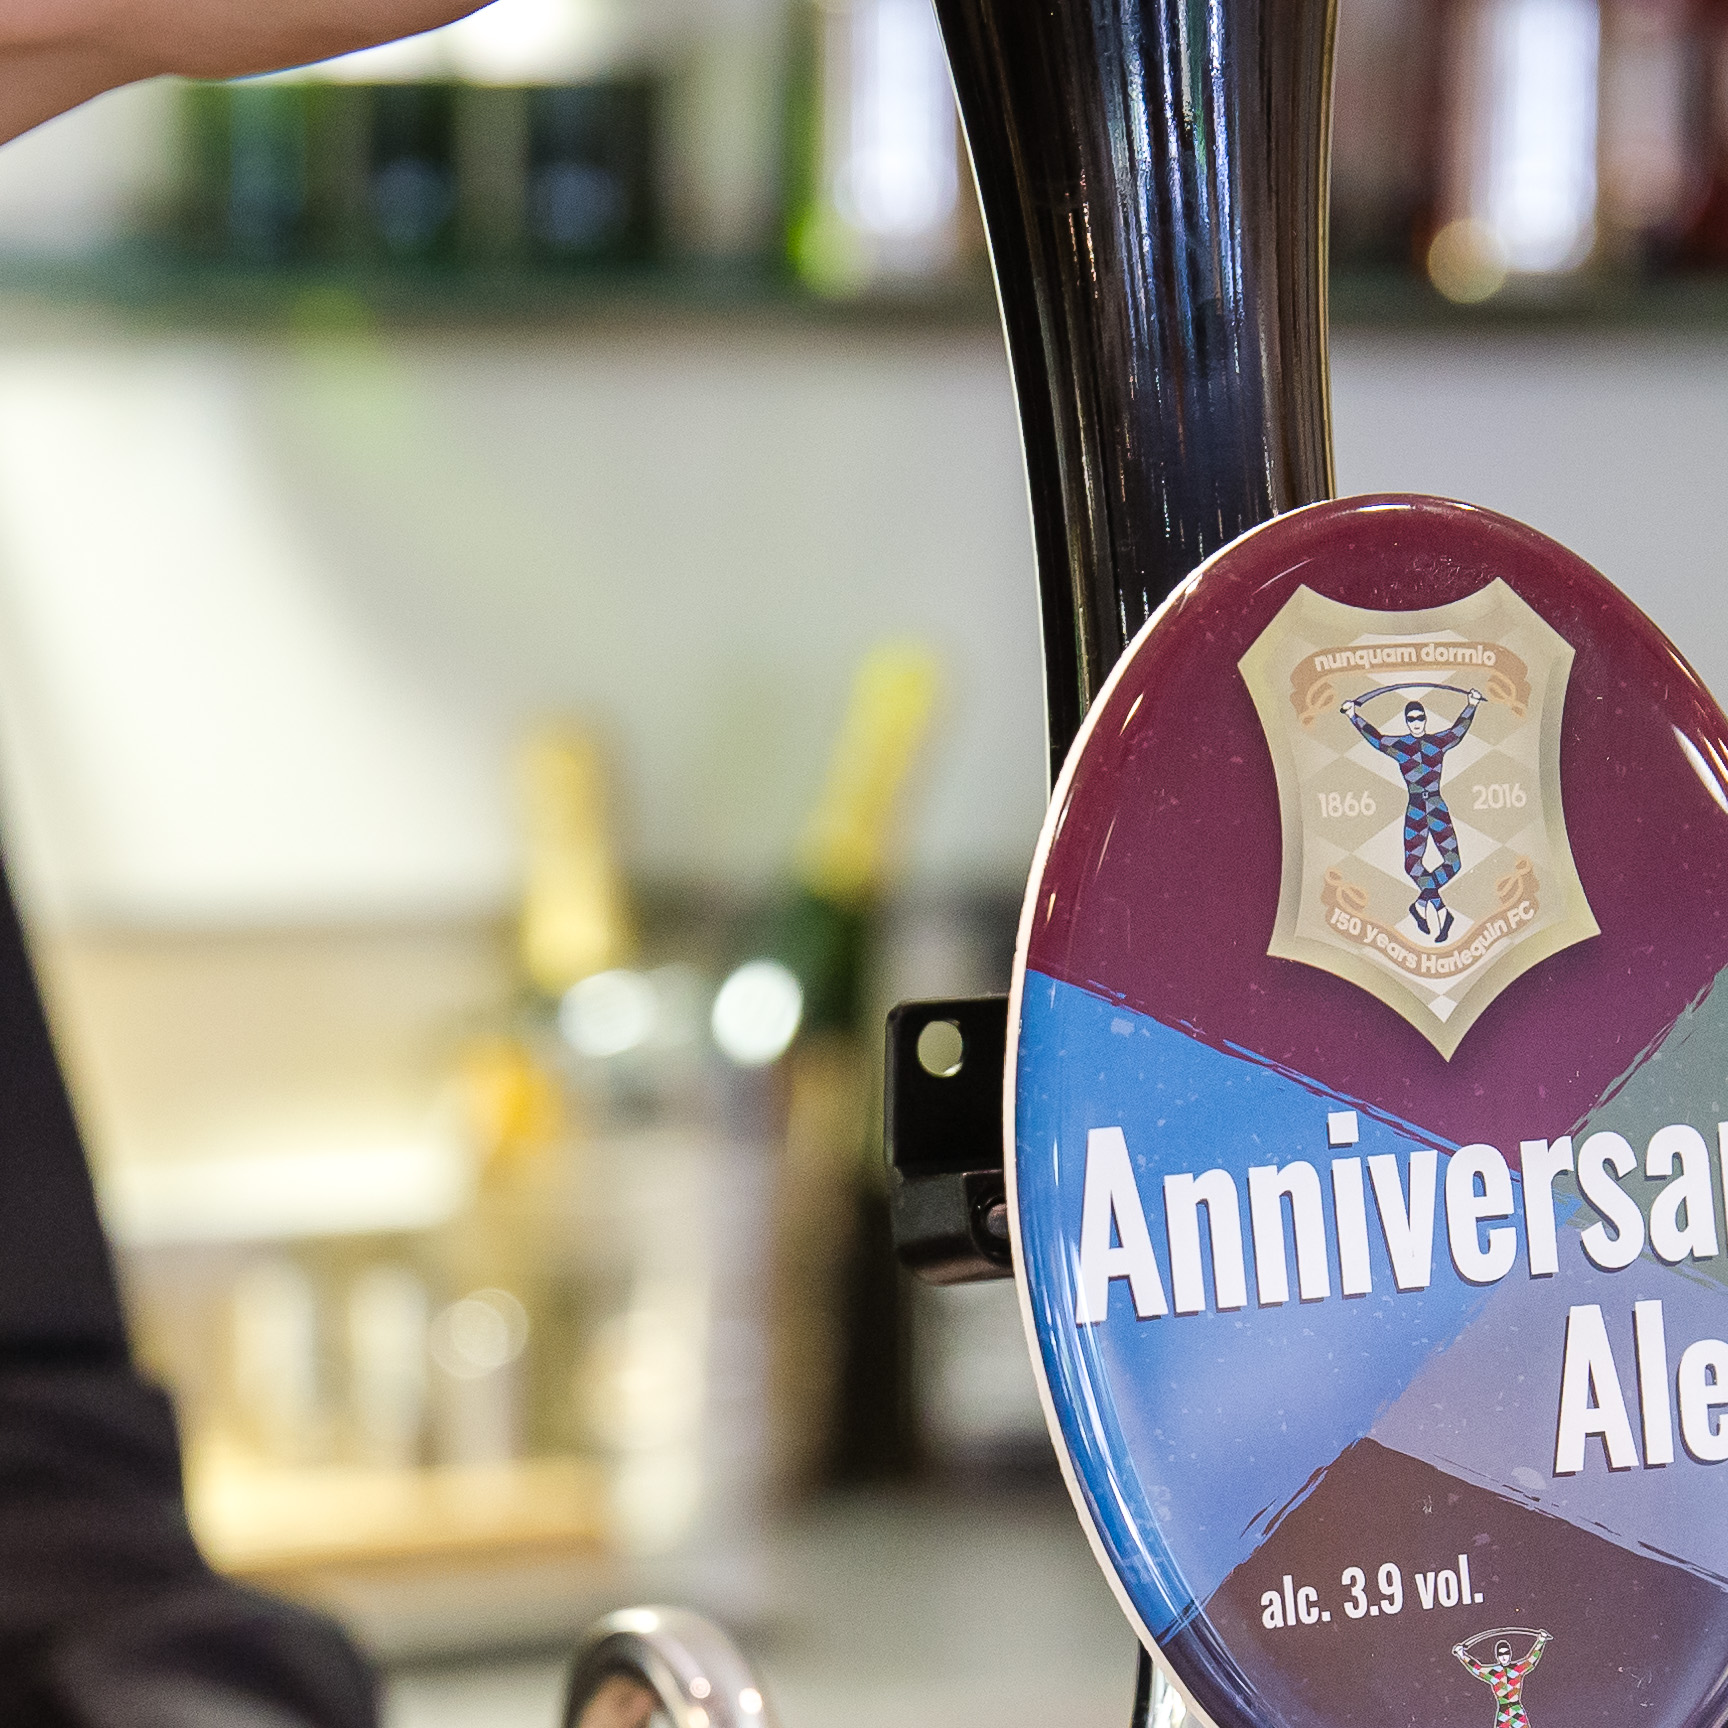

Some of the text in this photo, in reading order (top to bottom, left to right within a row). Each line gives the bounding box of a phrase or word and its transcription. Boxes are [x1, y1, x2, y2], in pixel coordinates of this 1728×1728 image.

[1314, 643, 1497, 672] nunquam dormio
[1319, 791, 1376, 818] 1866
[1472, 783, 1527, 810] 2016
[1330, 900, 1536, 974] 150 years Harlequin FC
[1260, 1555, 1484, 1629] alc. 3.9 vol.
